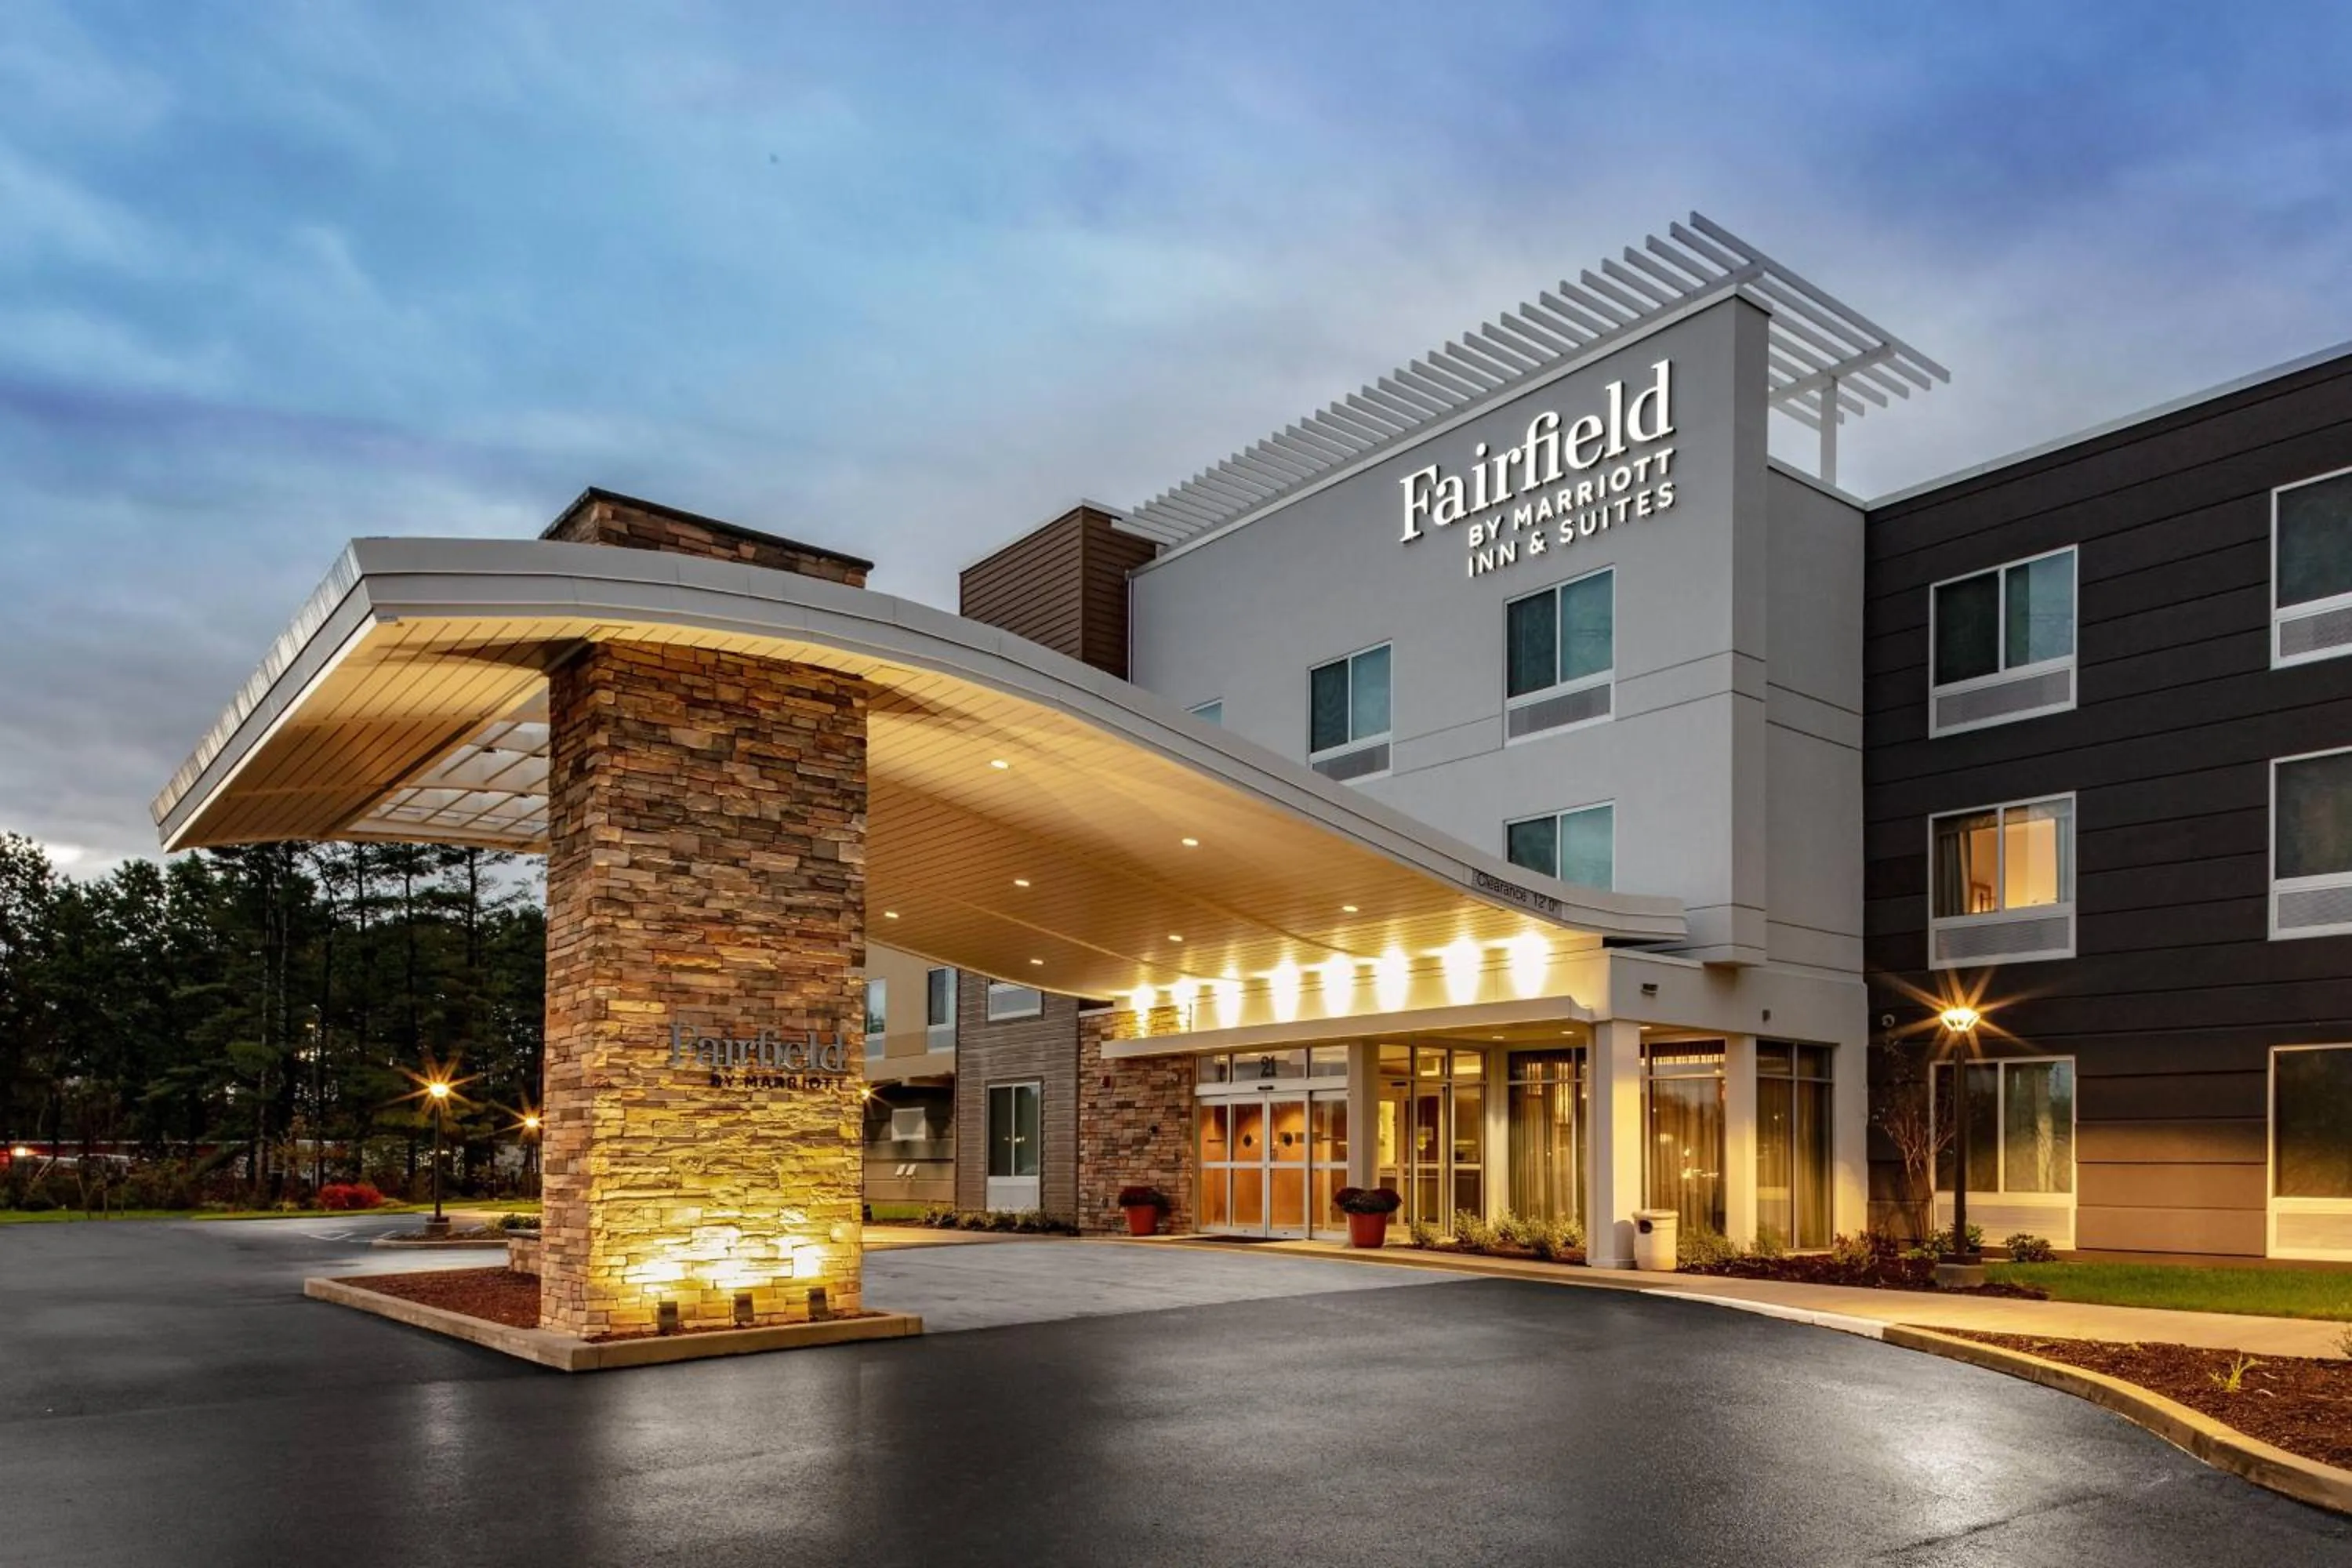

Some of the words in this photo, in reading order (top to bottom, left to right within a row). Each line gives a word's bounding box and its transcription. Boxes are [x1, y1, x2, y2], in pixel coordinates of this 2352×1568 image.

[1399, 358, 1675, 543] Fairfield
[1468, 514, 1502, 548] BY
[1514, 448, 1675, 532] MARRIOTT
[1468, 541, 1518, 577] INN
[1530, 532, 1547, 555] &
[1559, 482, 1675, 544] SUITES
[1475, 871, 1527, 902] Clearance
[670, 1024, 848, 1073] Fairfield
[1260, 1055, 1277, 1077] 21
[710, 1074, 734, 1088] BY
[745, 1075, 847, 1089] MARRIOTT
